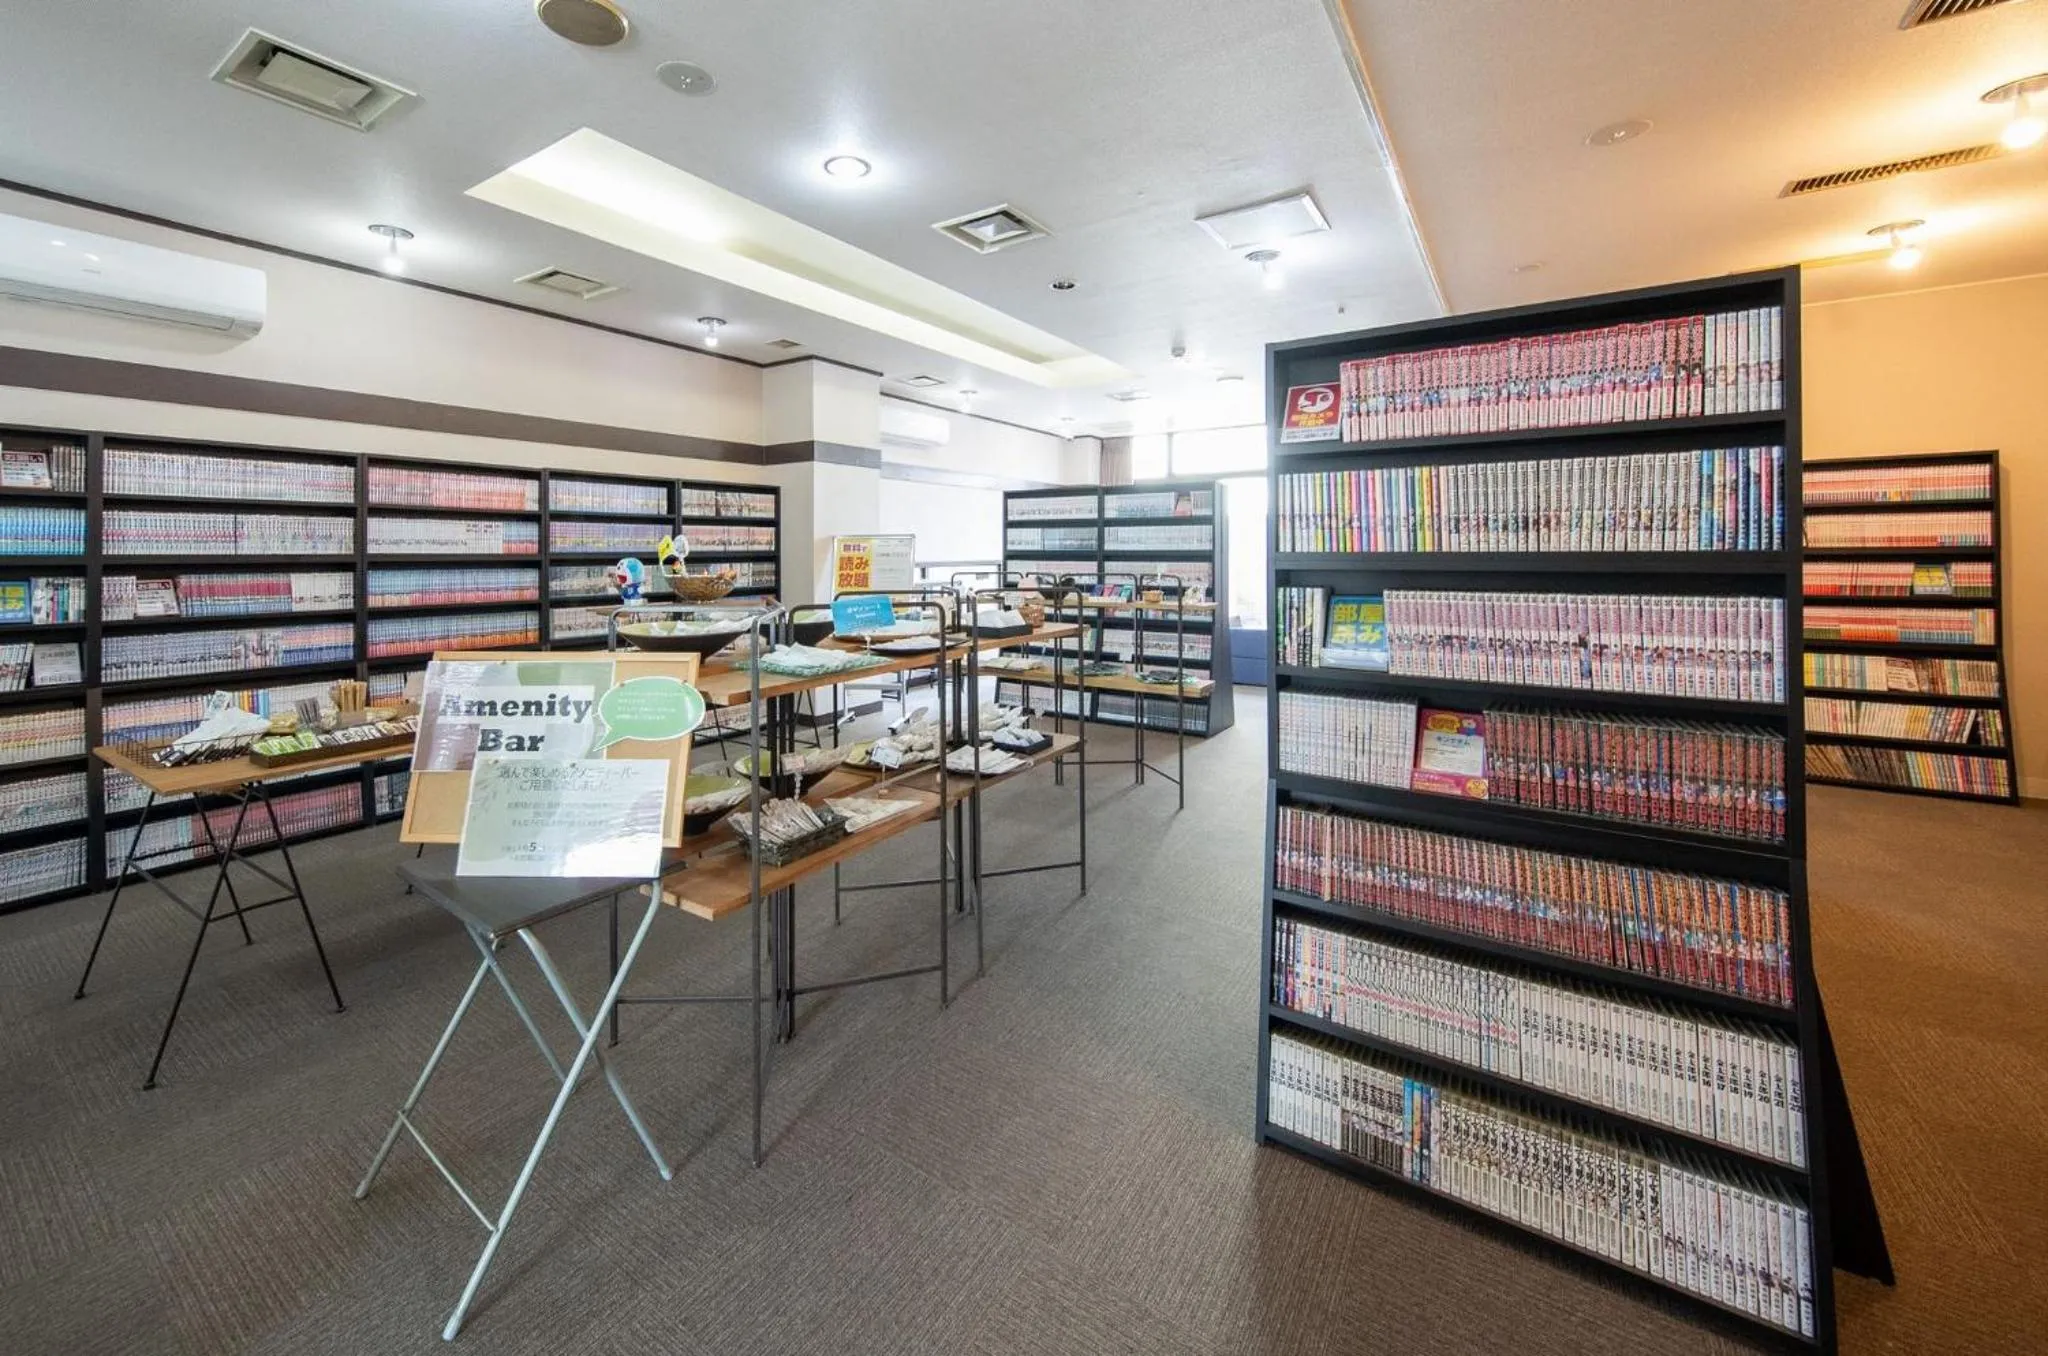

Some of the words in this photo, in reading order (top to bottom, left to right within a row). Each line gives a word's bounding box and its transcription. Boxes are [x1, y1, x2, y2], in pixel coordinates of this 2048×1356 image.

[838, 556, 870, 571] 読み
[838, 571, 870, 588] 放題
[440, 693, 592, 724] Amenity
[478, 728, 545, 751] Bar
